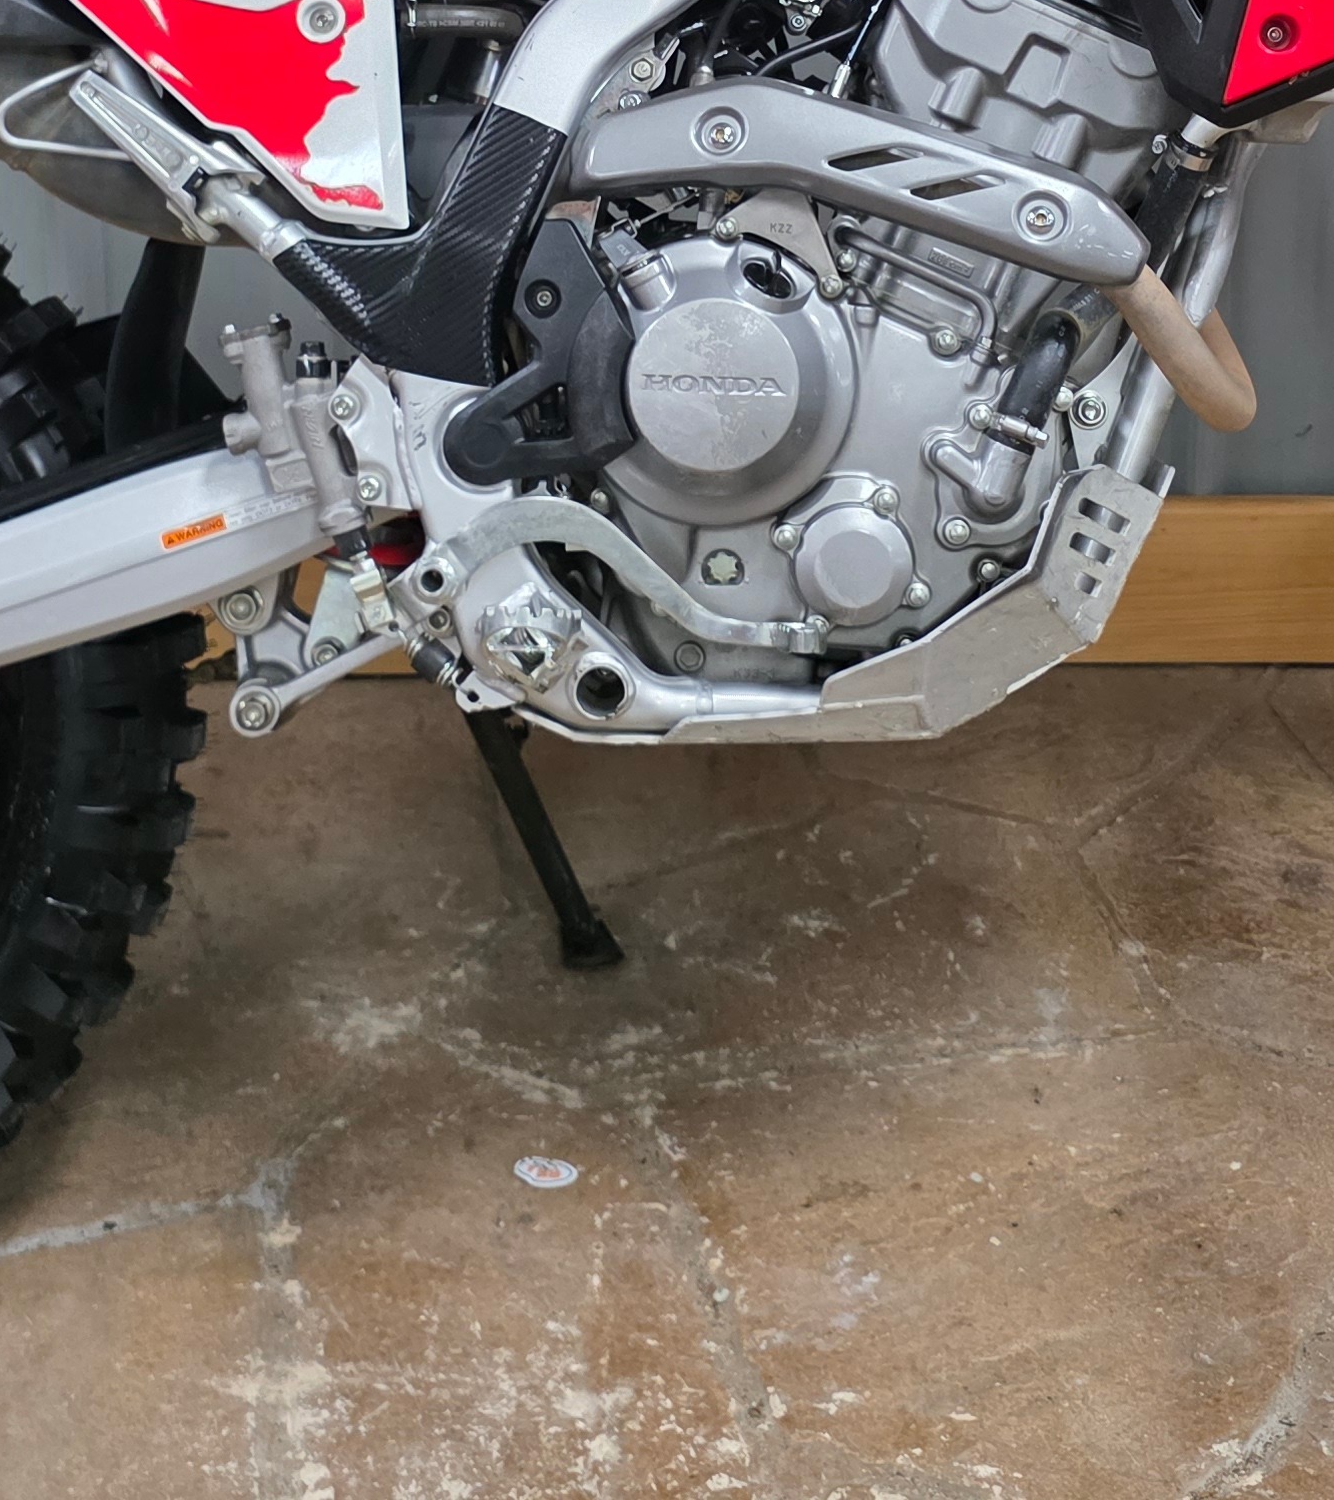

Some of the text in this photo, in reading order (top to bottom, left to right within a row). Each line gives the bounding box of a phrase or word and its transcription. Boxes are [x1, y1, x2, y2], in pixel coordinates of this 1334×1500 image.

[769, 222, 794, 235] KZZ
[640, 372, 788, 398] HONDA
[176, 517, 224, 542] WARNING
